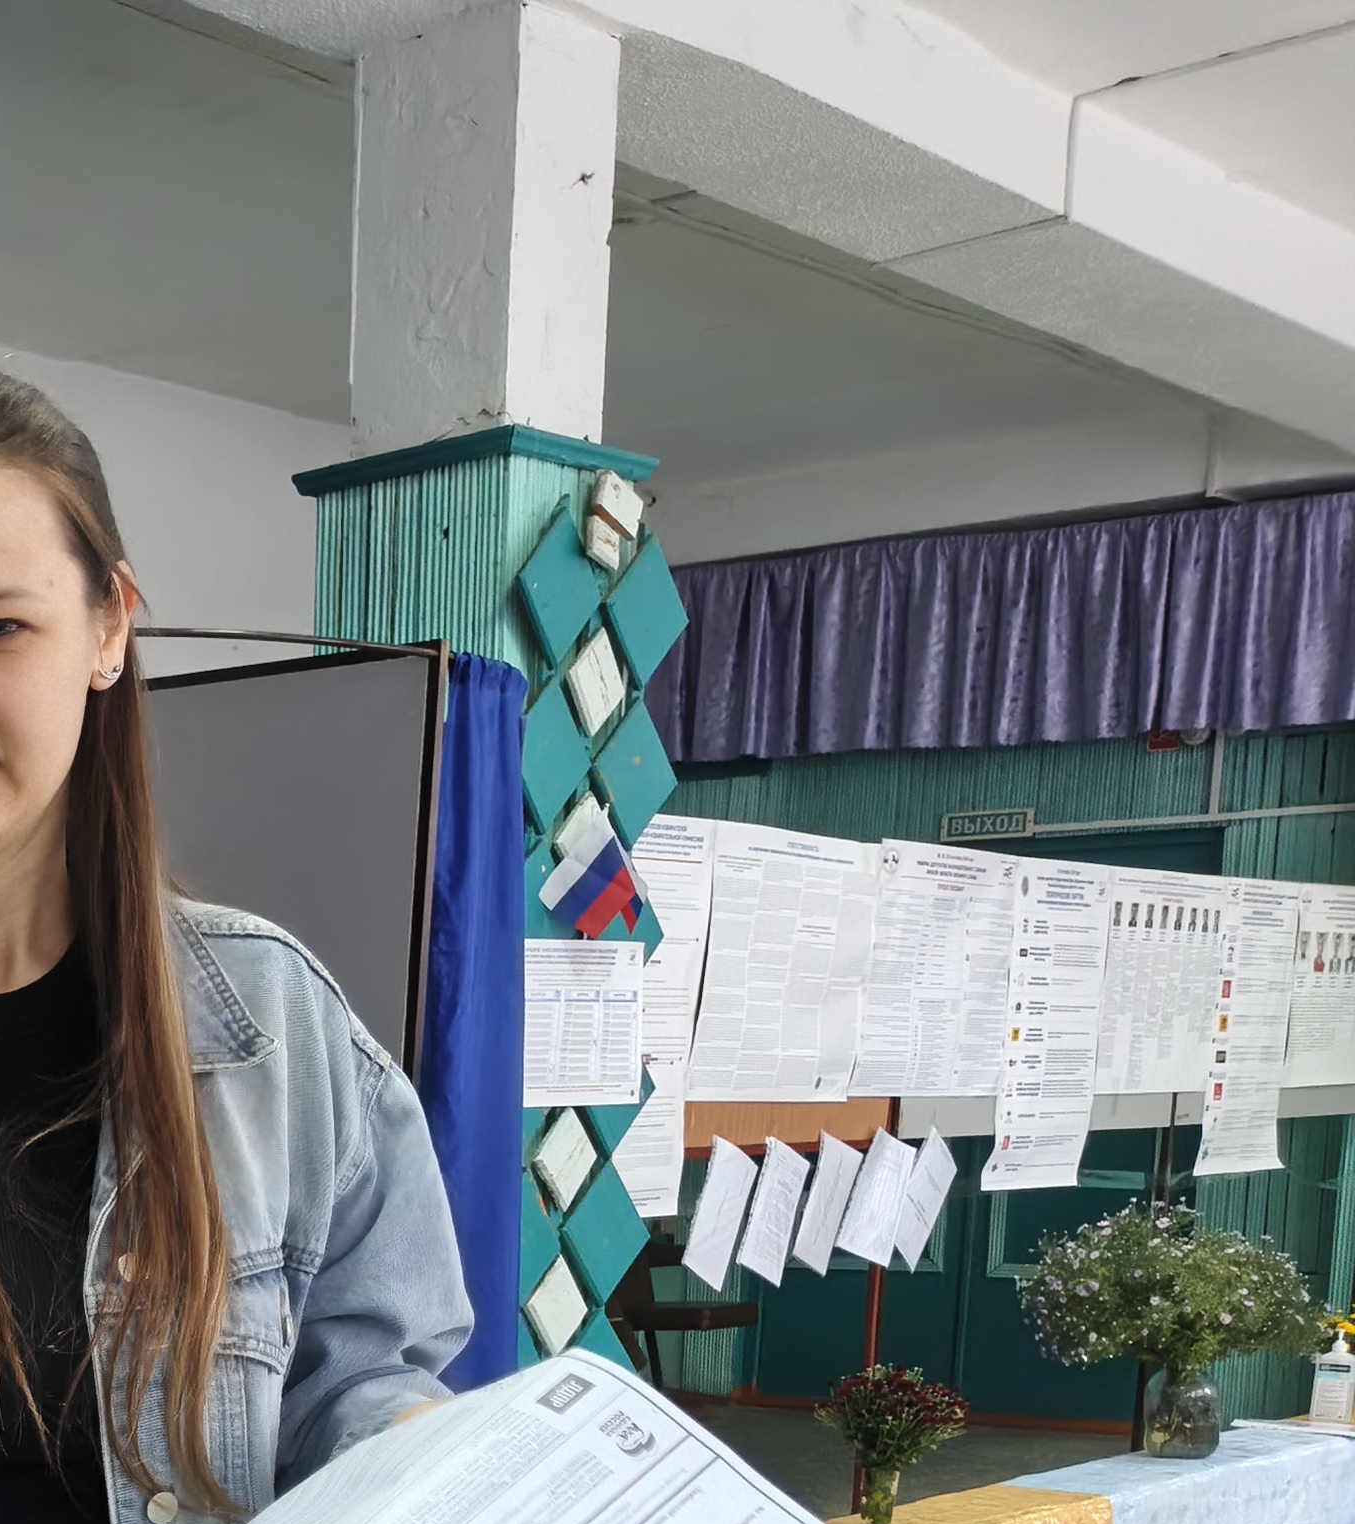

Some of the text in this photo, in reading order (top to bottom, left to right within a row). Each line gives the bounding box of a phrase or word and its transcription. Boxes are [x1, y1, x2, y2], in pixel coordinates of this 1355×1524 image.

[951, 814, 1024, 835] ВЫХОД
[548, 1378, 583, 1407] ЛДПР
[598, 1410, 625, 1432] РОССИЯ
